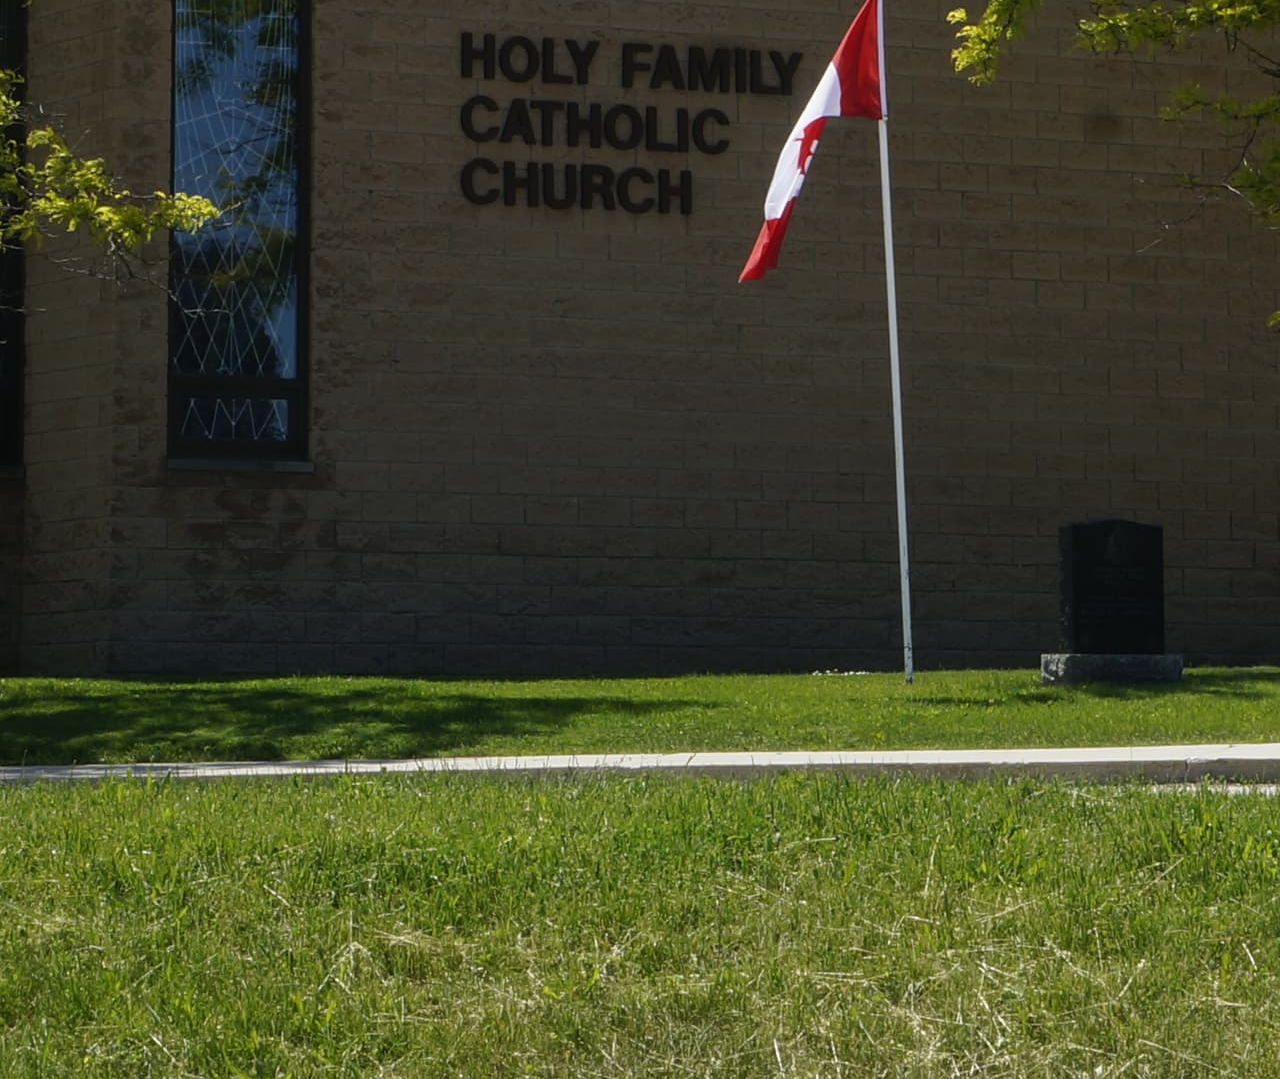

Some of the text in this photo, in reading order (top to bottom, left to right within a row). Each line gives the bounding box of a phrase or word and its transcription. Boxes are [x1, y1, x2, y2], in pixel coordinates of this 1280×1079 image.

[460, 32, 803, 95] HOLY FAMILY
[460, 95, 730, 155] CATHOLIC
[460, 158, 693, 215] CHURCH
